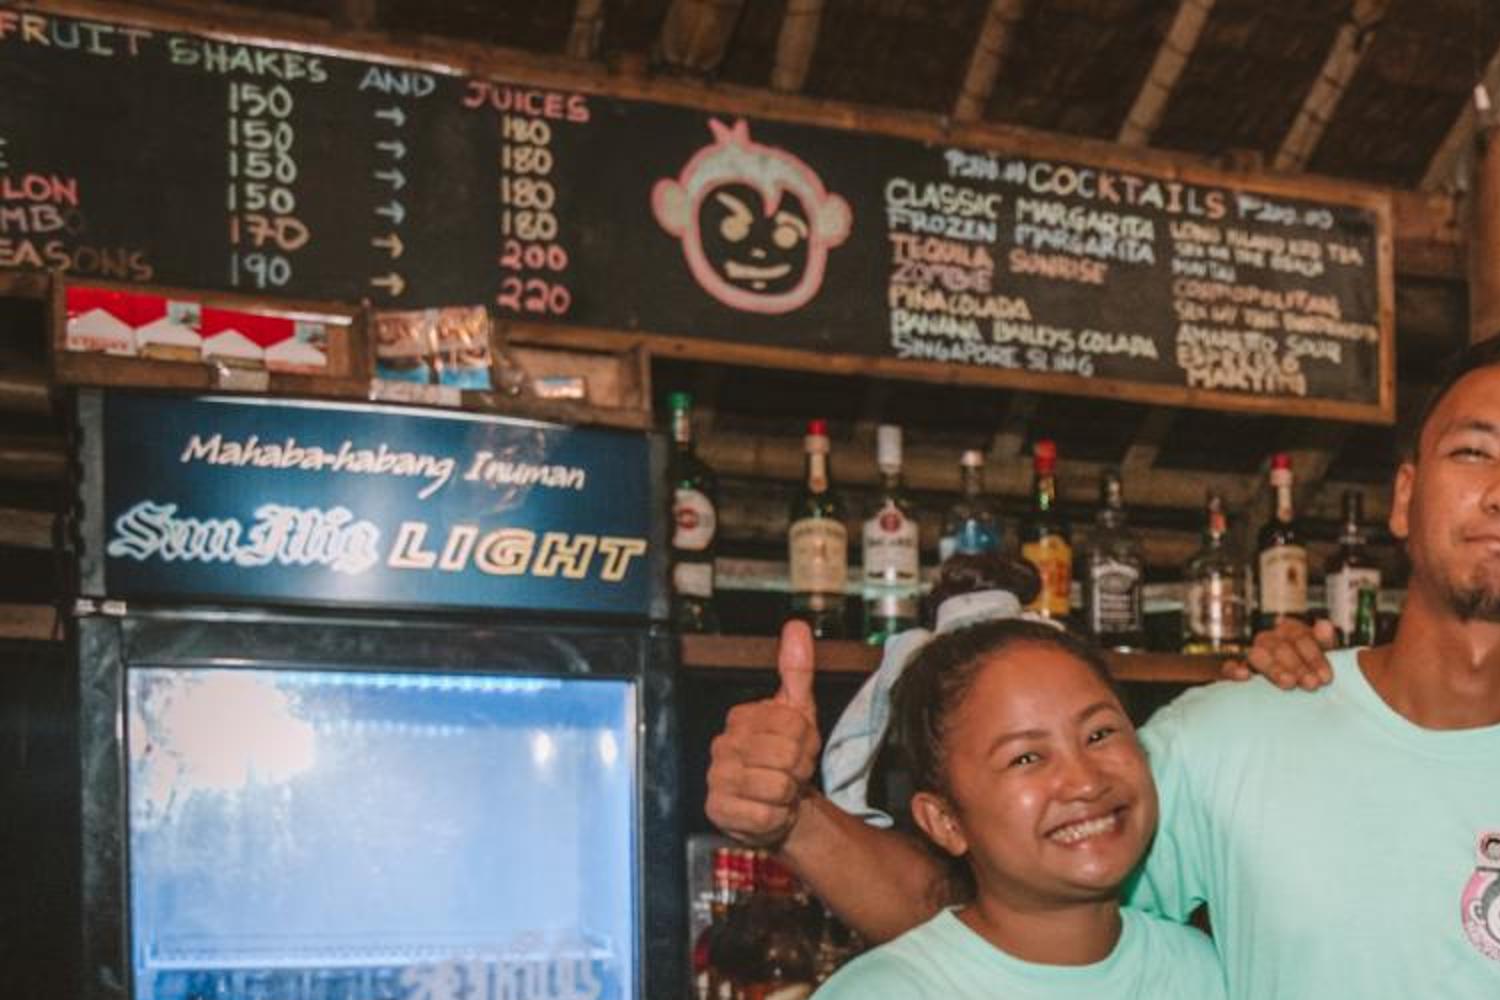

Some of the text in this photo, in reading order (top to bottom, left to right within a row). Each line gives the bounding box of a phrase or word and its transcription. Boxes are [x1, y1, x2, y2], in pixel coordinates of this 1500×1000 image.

[0, 11, 591, 123] FRUIT SHAKES AND JUICES
[229, 82, 293, 118] 150
[229, 118, 554, 176] 150 180
[230, 151, 556, 210] 150 180
[886, 177, 1155, 241] CLASSIC MARGARITA
[1027, 161, 1227, 220] COCKTAILS
[228, 183, 296, 214] 150
[503, 210, 558, 241] 180
[888, 206, 1155, 264] FROZEN MARGARITA
[229, 214, 311, 250] 170
[500, 240, 568, 271] 200
[889, 231, 1108, 284] TEQUILA SUNRISE
[232, 252, 291, 289] 190
[497, 277, 571, 315] 220
[896, 336, 1023, 370] SINGAPORE
[463, 450, 586, 492] Inuman
[387, 520, 647, 584] LIGHT
